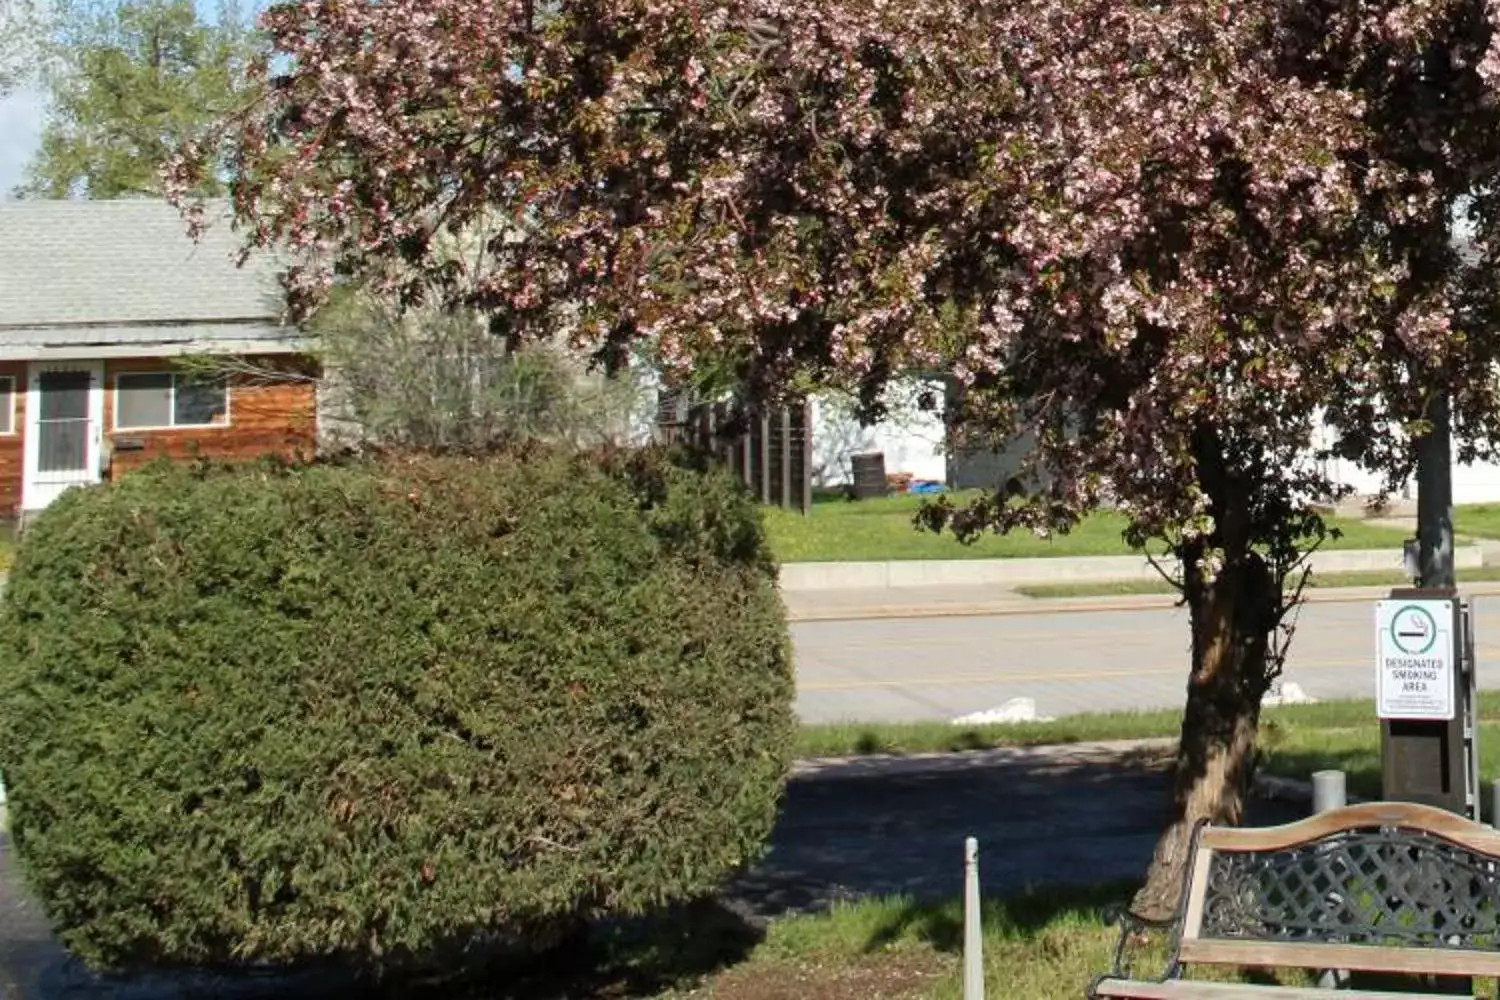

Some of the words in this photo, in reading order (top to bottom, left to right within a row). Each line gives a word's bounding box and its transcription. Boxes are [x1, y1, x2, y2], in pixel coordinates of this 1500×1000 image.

[1385, 658, 1443, 669] DESIGNATED
[1391, 669, 1437, 681] SMOKING
[1402, 681, 1428, 692] AREA
